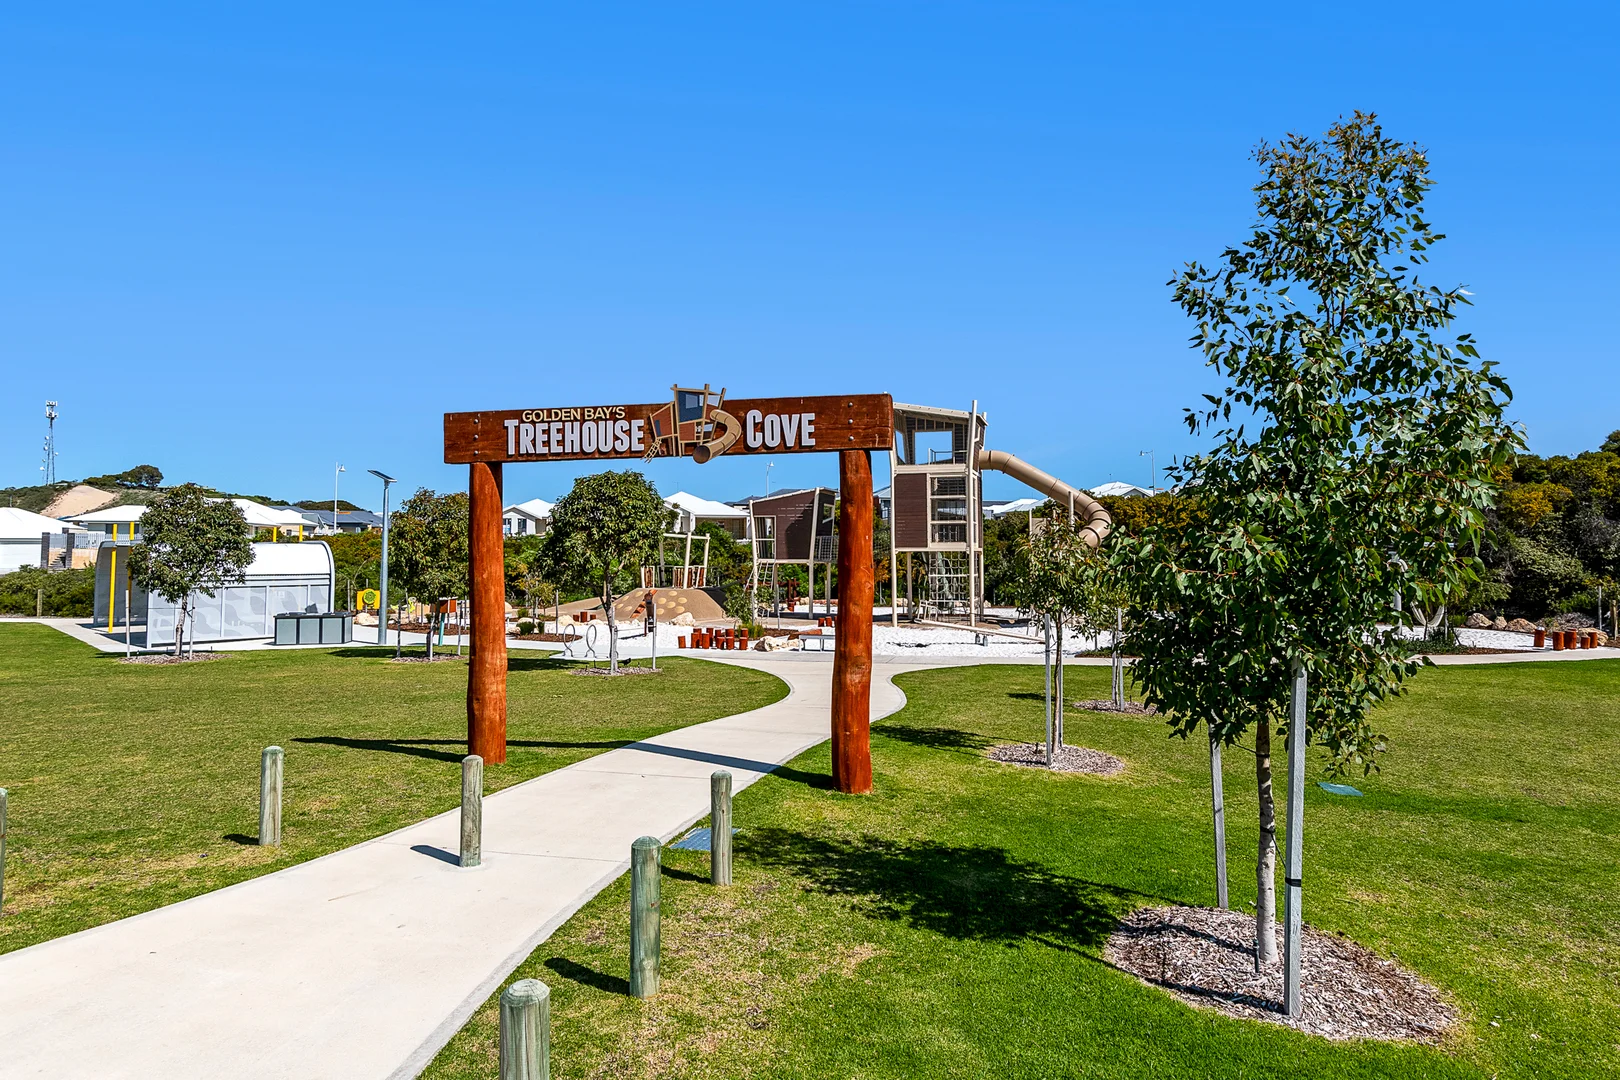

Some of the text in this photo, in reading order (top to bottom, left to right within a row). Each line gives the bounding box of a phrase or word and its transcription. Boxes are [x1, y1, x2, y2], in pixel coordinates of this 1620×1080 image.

[522, 406, 626, 422] GOLDEN BAY'S
[504, 409, 816, 455] TREEHOUSE COVE
